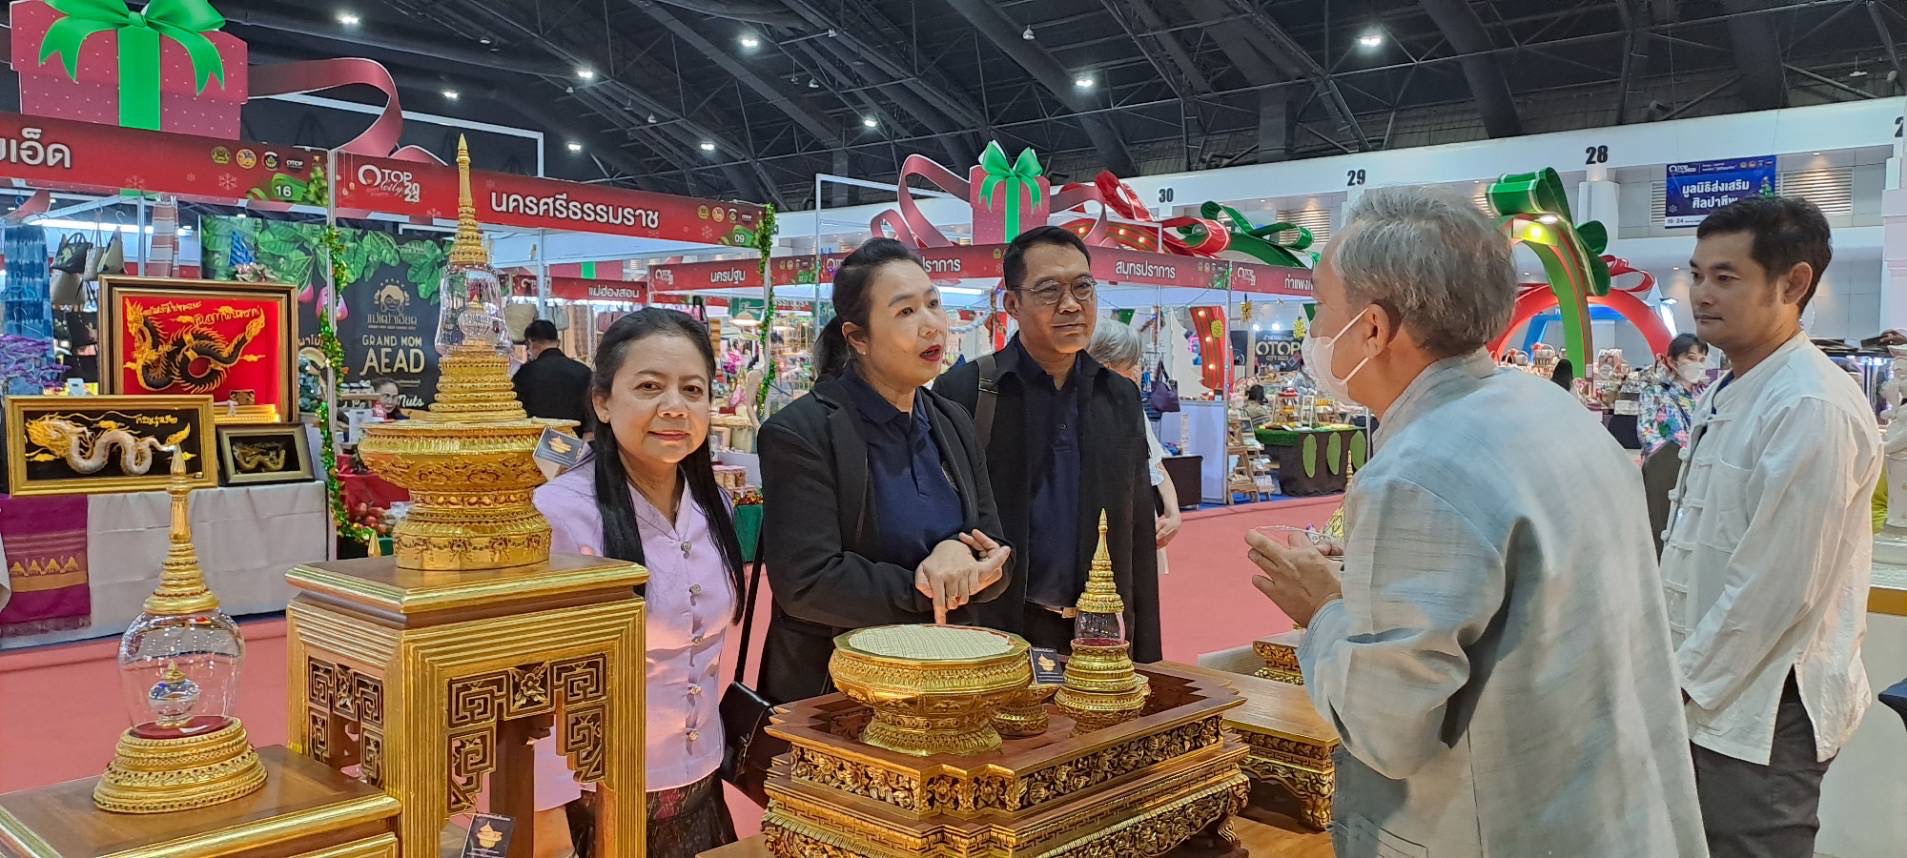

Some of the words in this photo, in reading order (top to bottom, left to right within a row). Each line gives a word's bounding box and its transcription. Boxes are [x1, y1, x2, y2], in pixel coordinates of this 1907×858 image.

[1585, 145, 1608, 165] 28
[358, 164, 412, 187] OTOP
[1347, 168, 1367, 186] 29
[275, 185, 292, 197] 16
[1158, 187, 1174, 203] 30
[1682, 178, 1750, 198] มูลนิธิส่งเสริม
[491, 191, 660, 229] นครศรีธรรมราช
[734, 234, 745, 243] 09
[709, 266, 746, 285] นครปฐม
[1115, 259, 1176, 281] สมุทรปราการ
[587, 284, 640, 298] แม่ฮ่องสอน
[361, 334, 398, 347] GRAND
[400, 336, 423, 348] MOM
[1255, 340, 1301, 357] OTOP
[359, 346, 425, 376] AEAD
